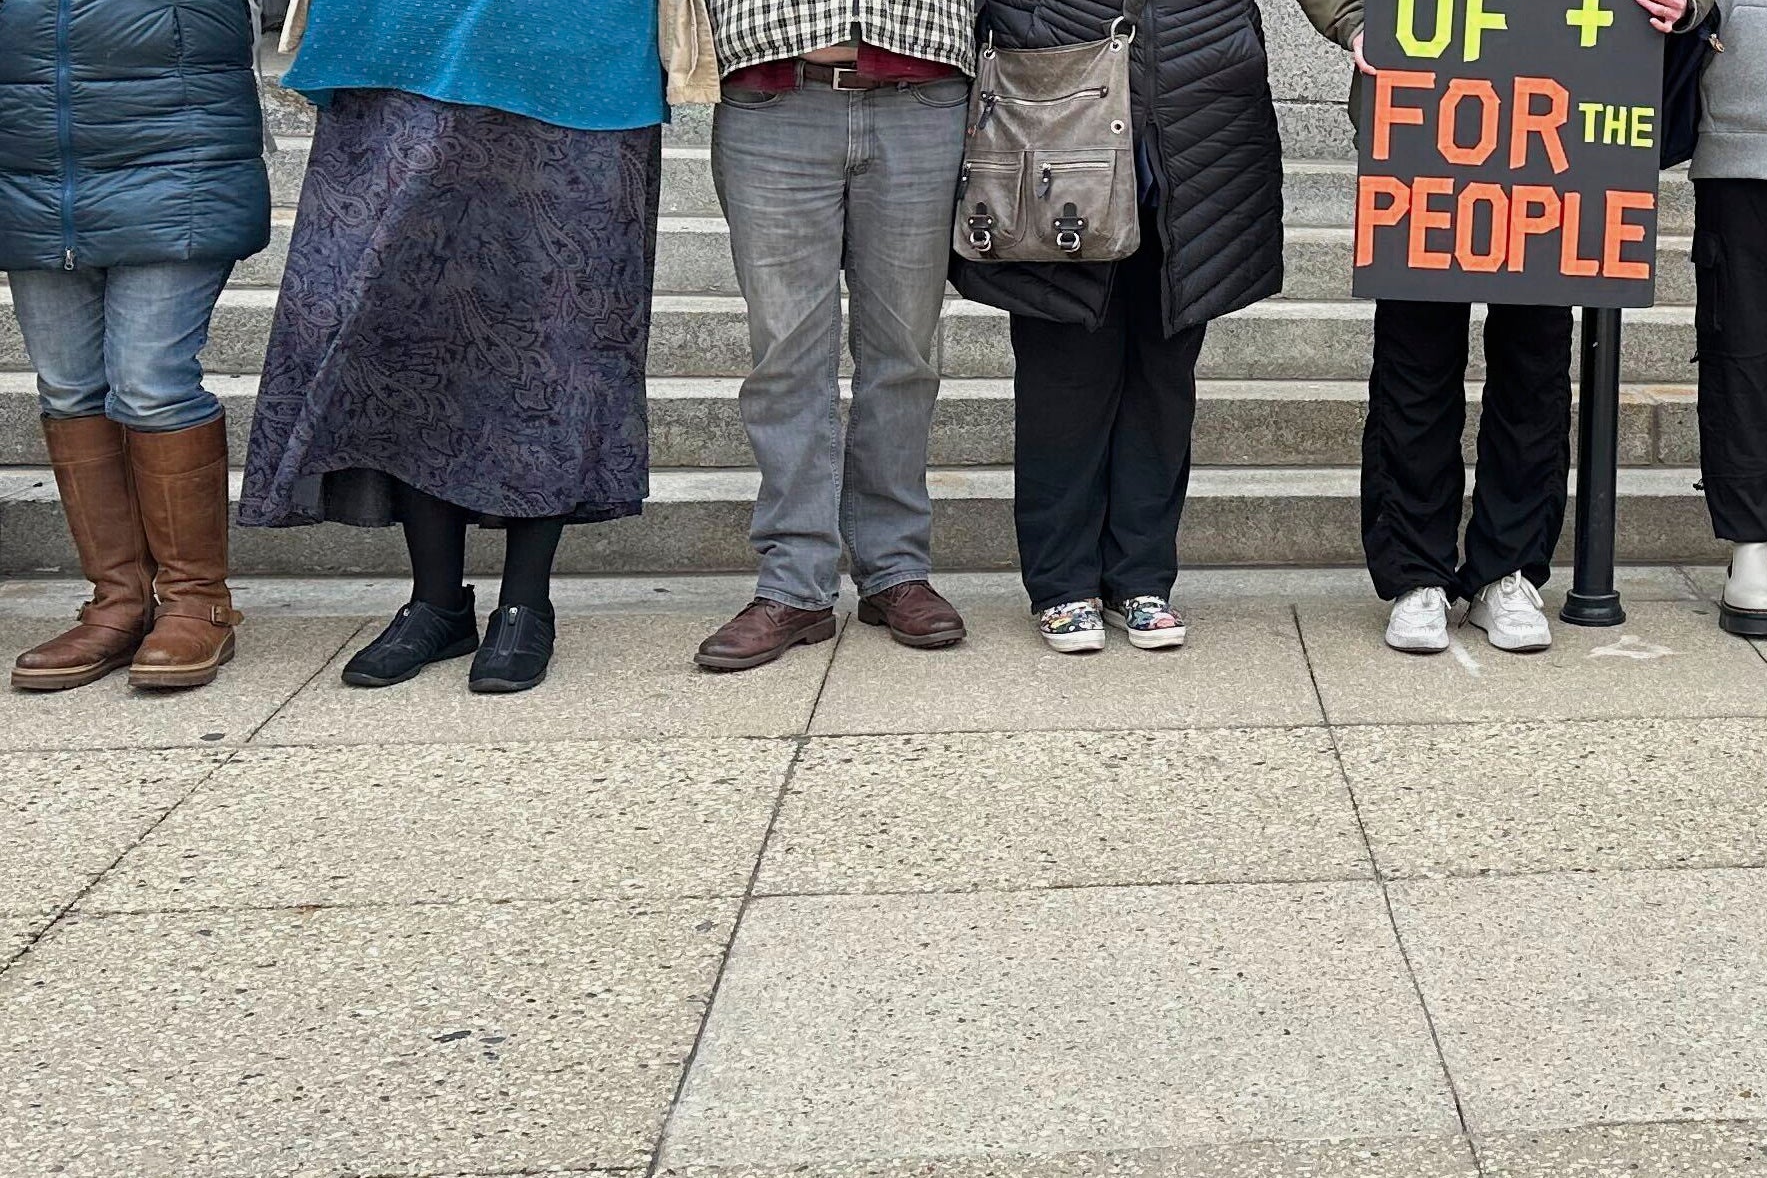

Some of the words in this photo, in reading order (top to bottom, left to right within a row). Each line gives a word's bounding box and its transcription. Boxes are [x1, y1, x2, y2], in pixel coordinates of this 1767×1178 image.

[1372, 70, 1569, 174] FOR
[1578, 102, 1656, 148] THE
[1355, 175, 1656, 280] PEOPLE
